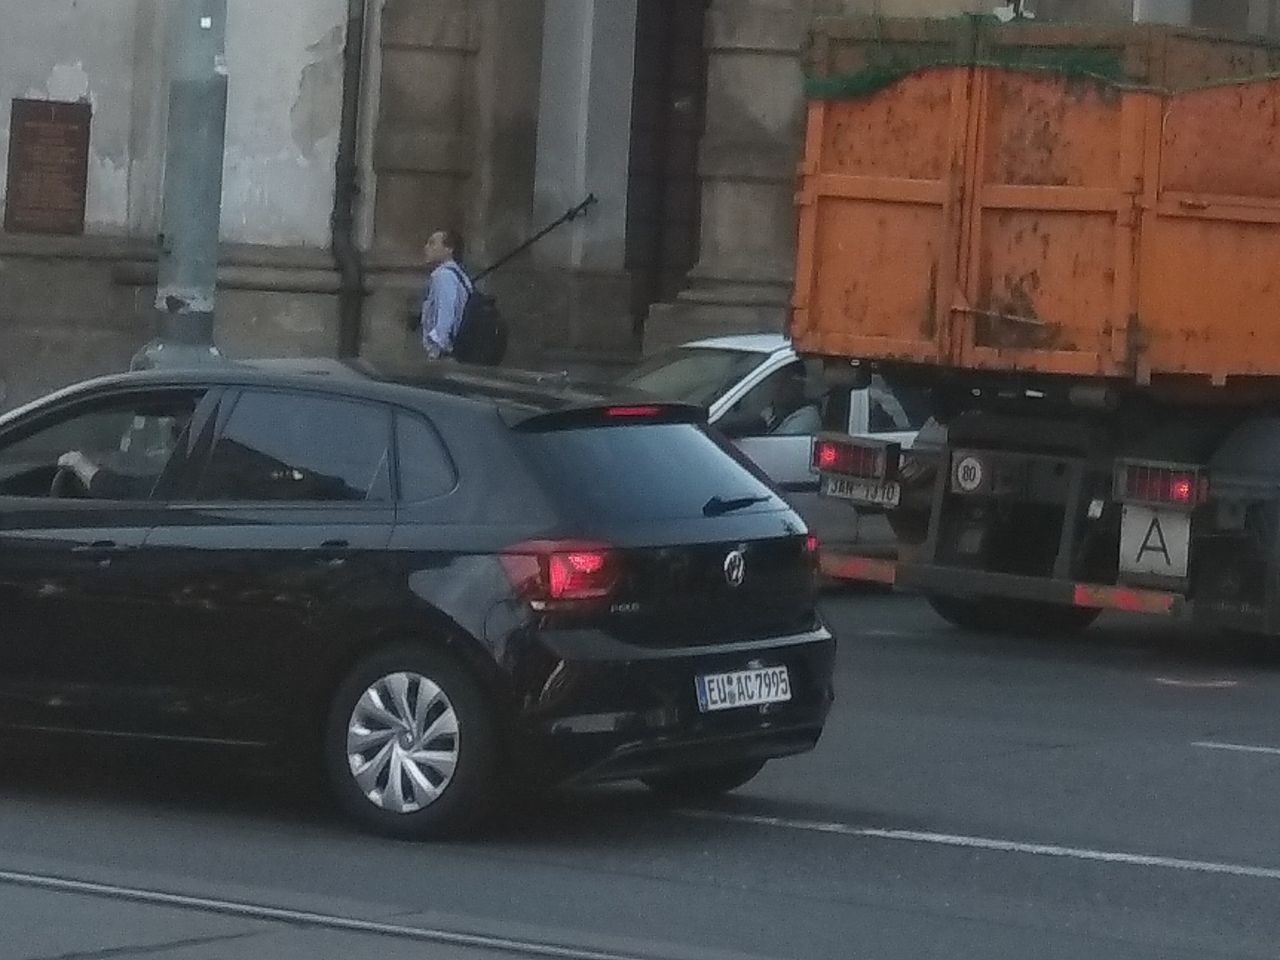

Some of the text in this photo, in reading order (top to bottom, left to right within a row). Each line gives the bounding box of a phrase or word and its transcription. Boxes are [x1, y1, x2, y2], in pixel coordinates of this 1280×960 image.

[963, 465, 976, 482] 80
[1136, 517, 1171, 565] A
[708, 675, 727, 705] EU
